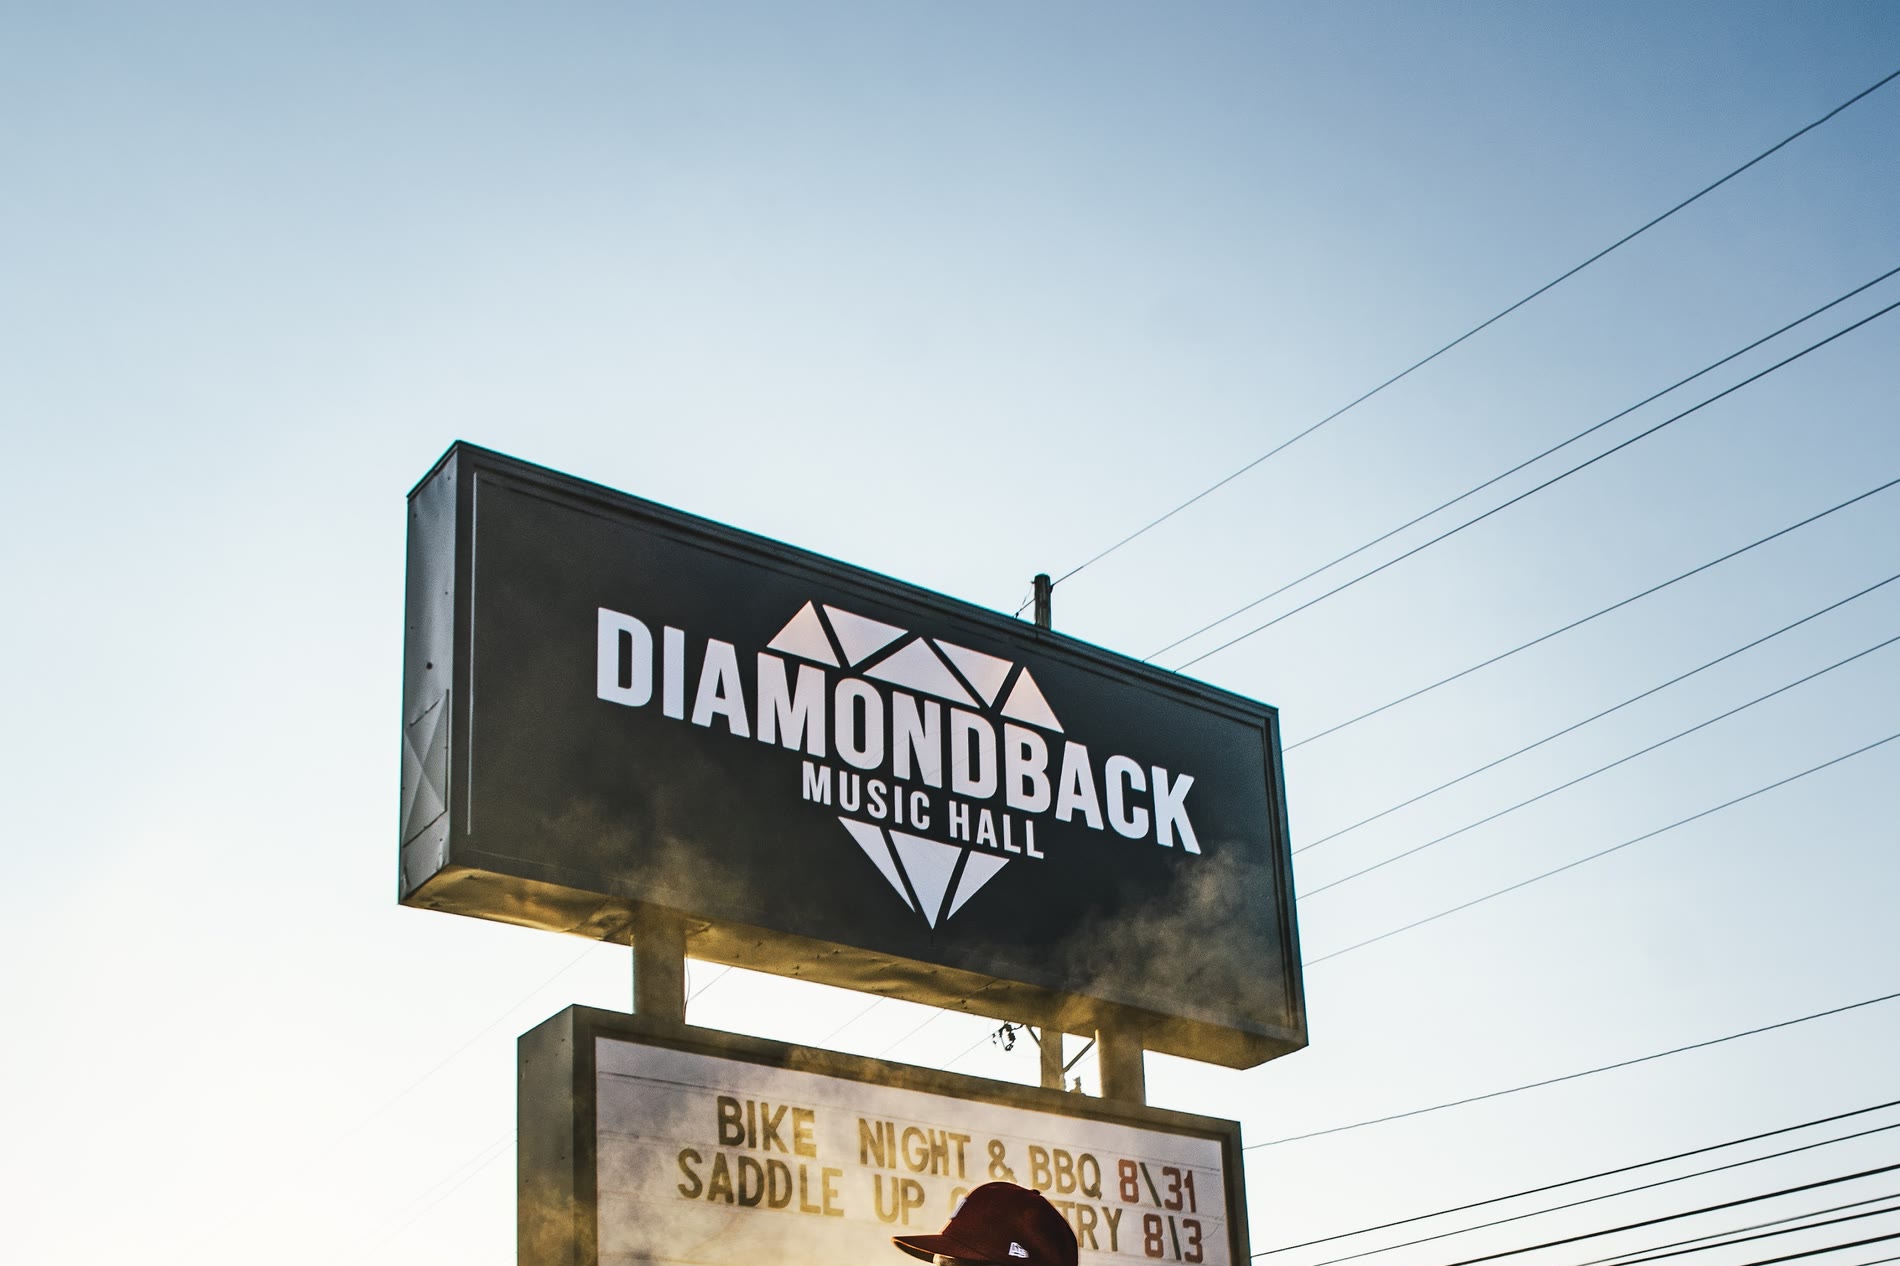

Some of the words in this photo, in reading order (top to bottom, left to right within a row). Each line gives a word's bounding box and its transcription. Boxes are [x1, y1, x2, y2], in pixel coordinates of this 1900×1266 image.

[597, 607, 1201, 854] DIAMONDBACK
[802, 761, 931, 829] MUSIC
[948, 800, 1045, 860] HALL
[677, 1148, 844, 1217] SADDLE
[874, 1174, 925, 1225] UP
[717, 1096, 816, 1159] BIKE
[858, 1118, 971, 1179] NIGHT
[987, 1139, 1018, 1183] &
[1029, 1145, 1102, 1200] BBQ
